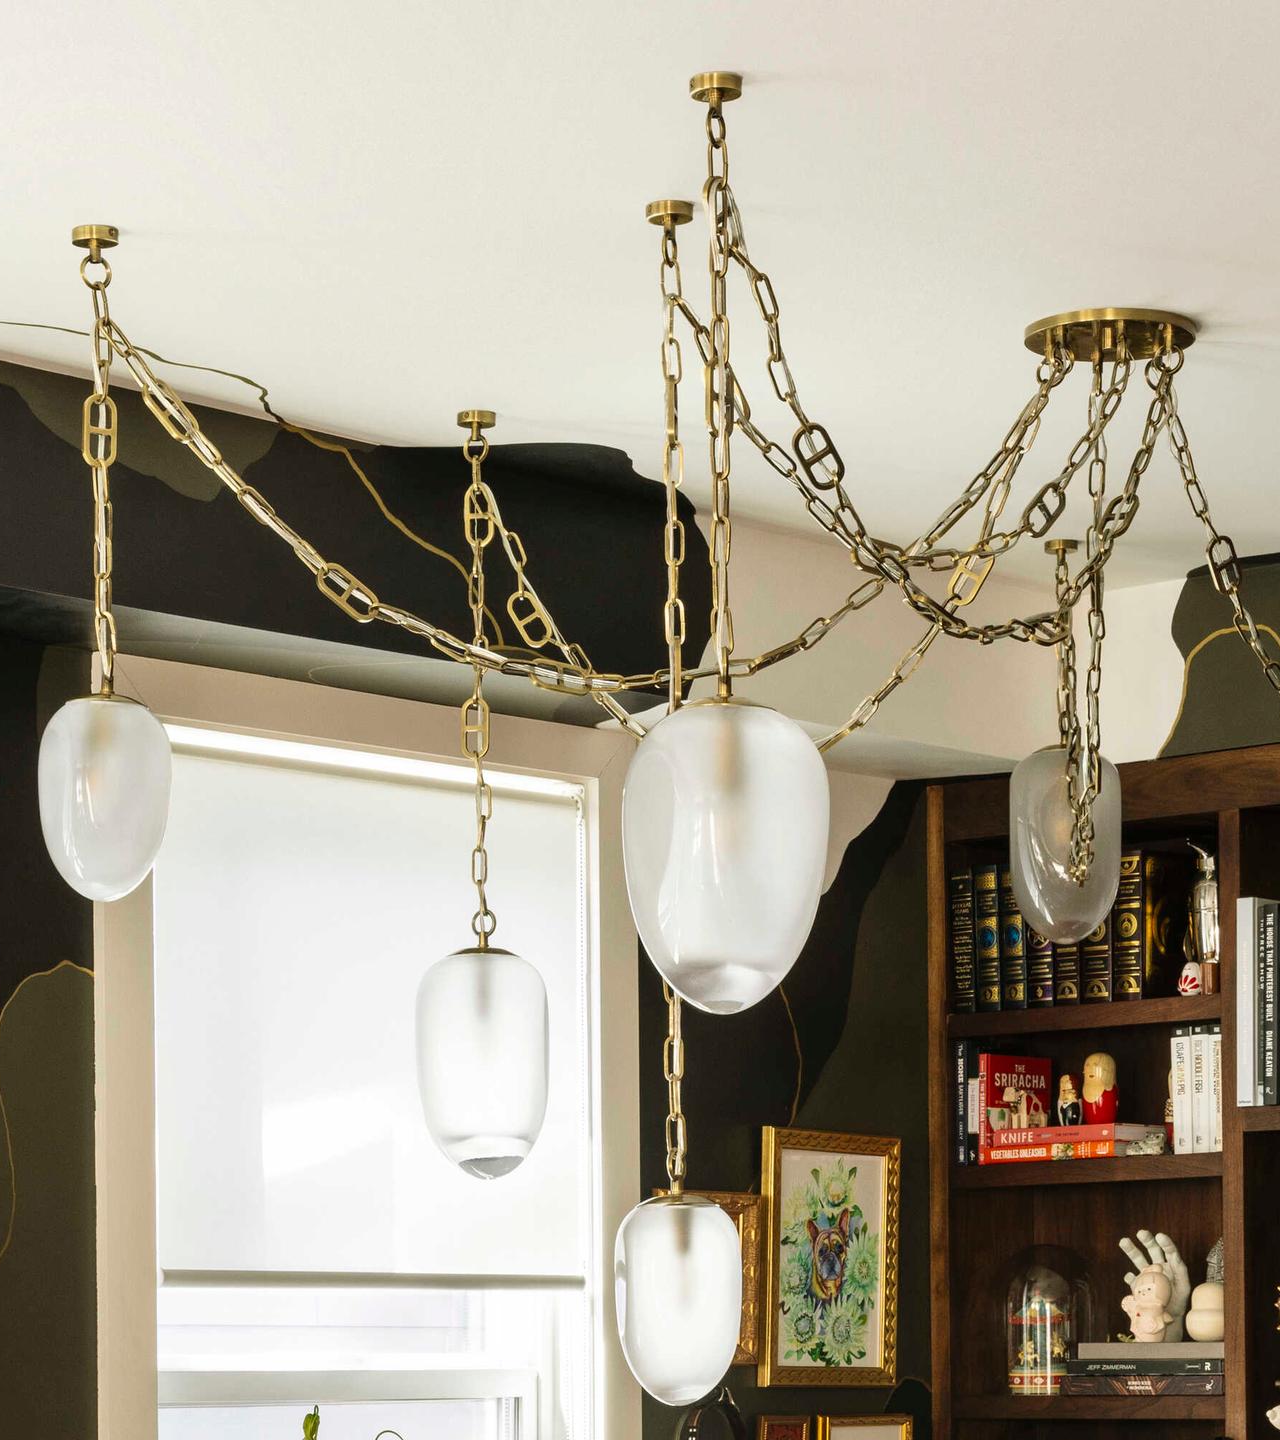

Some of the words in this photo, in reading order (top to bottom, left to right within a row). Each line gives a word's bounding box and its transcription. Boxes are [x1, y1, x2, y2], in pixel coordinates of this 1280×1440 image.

[1265, 1030, 1273, 1050] DIANE
[1015, 1064, 1026, 1073] THE
[994, 1072, 1046, 1089] SRIRACHA
[1195, 1079, 1203, 1094] FISH
[1000, 1131, 1034, 1143] KNIFE
[991, 1150, 1020, 1160] VEGETABLES
[1019, 1147, 1047, 1159] UNLEASHED
